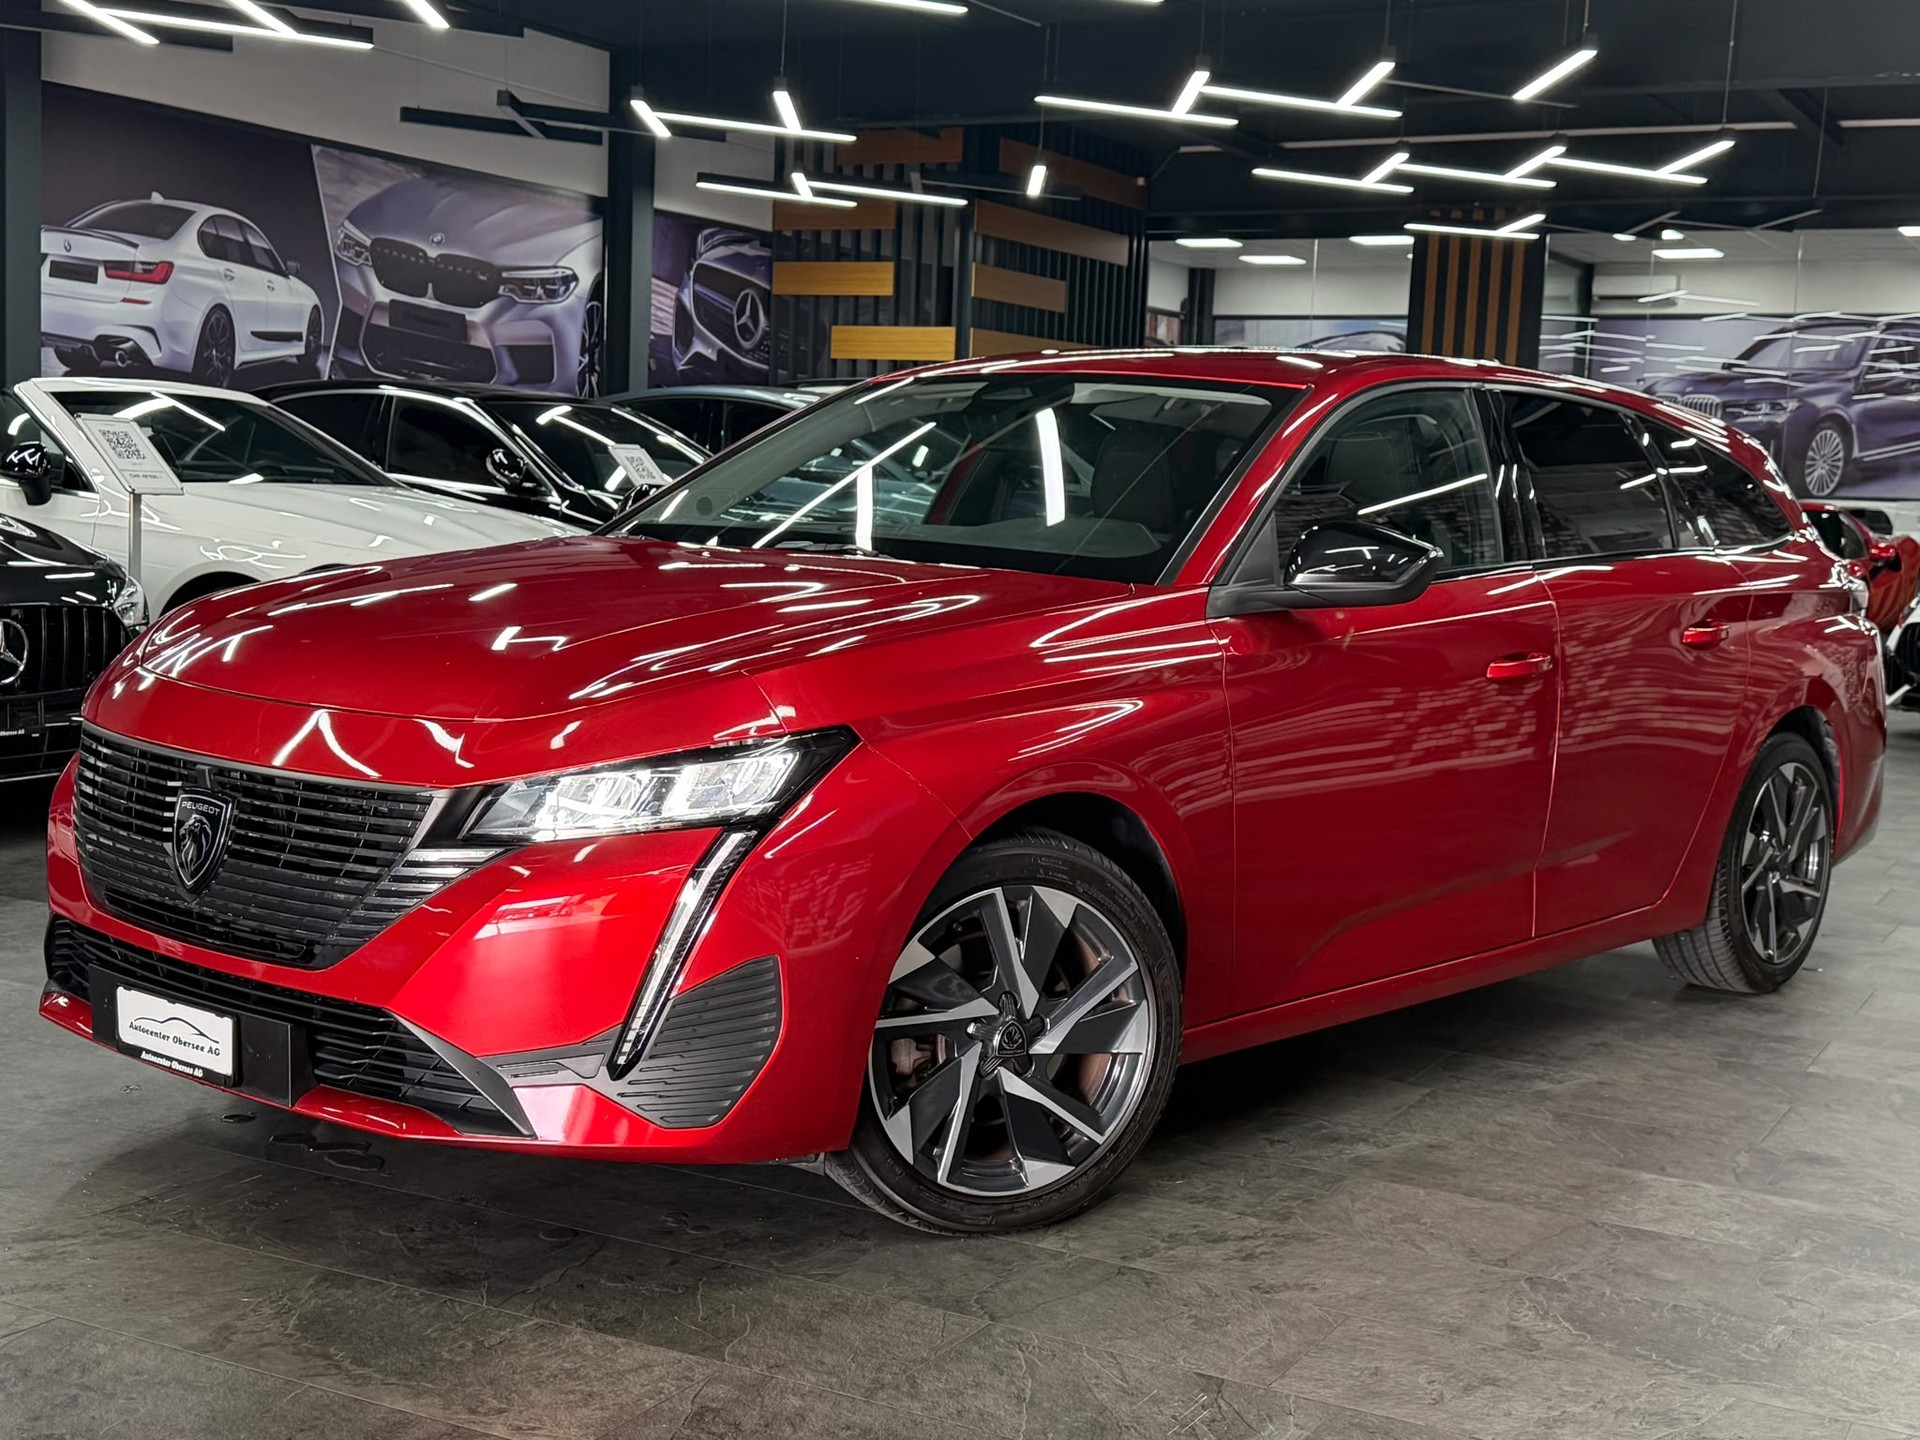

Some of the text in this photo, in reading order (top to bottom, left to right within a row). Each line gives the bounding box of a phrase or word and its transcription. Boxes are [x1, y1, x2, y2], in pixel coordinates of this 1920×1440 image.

[182, 801, 220, 815] PEUGEOT
[129, 1021, 221, 1056] Autocenter Obersee AG
[140, 1050, 203, 1077] Autocenter Obersee AG
